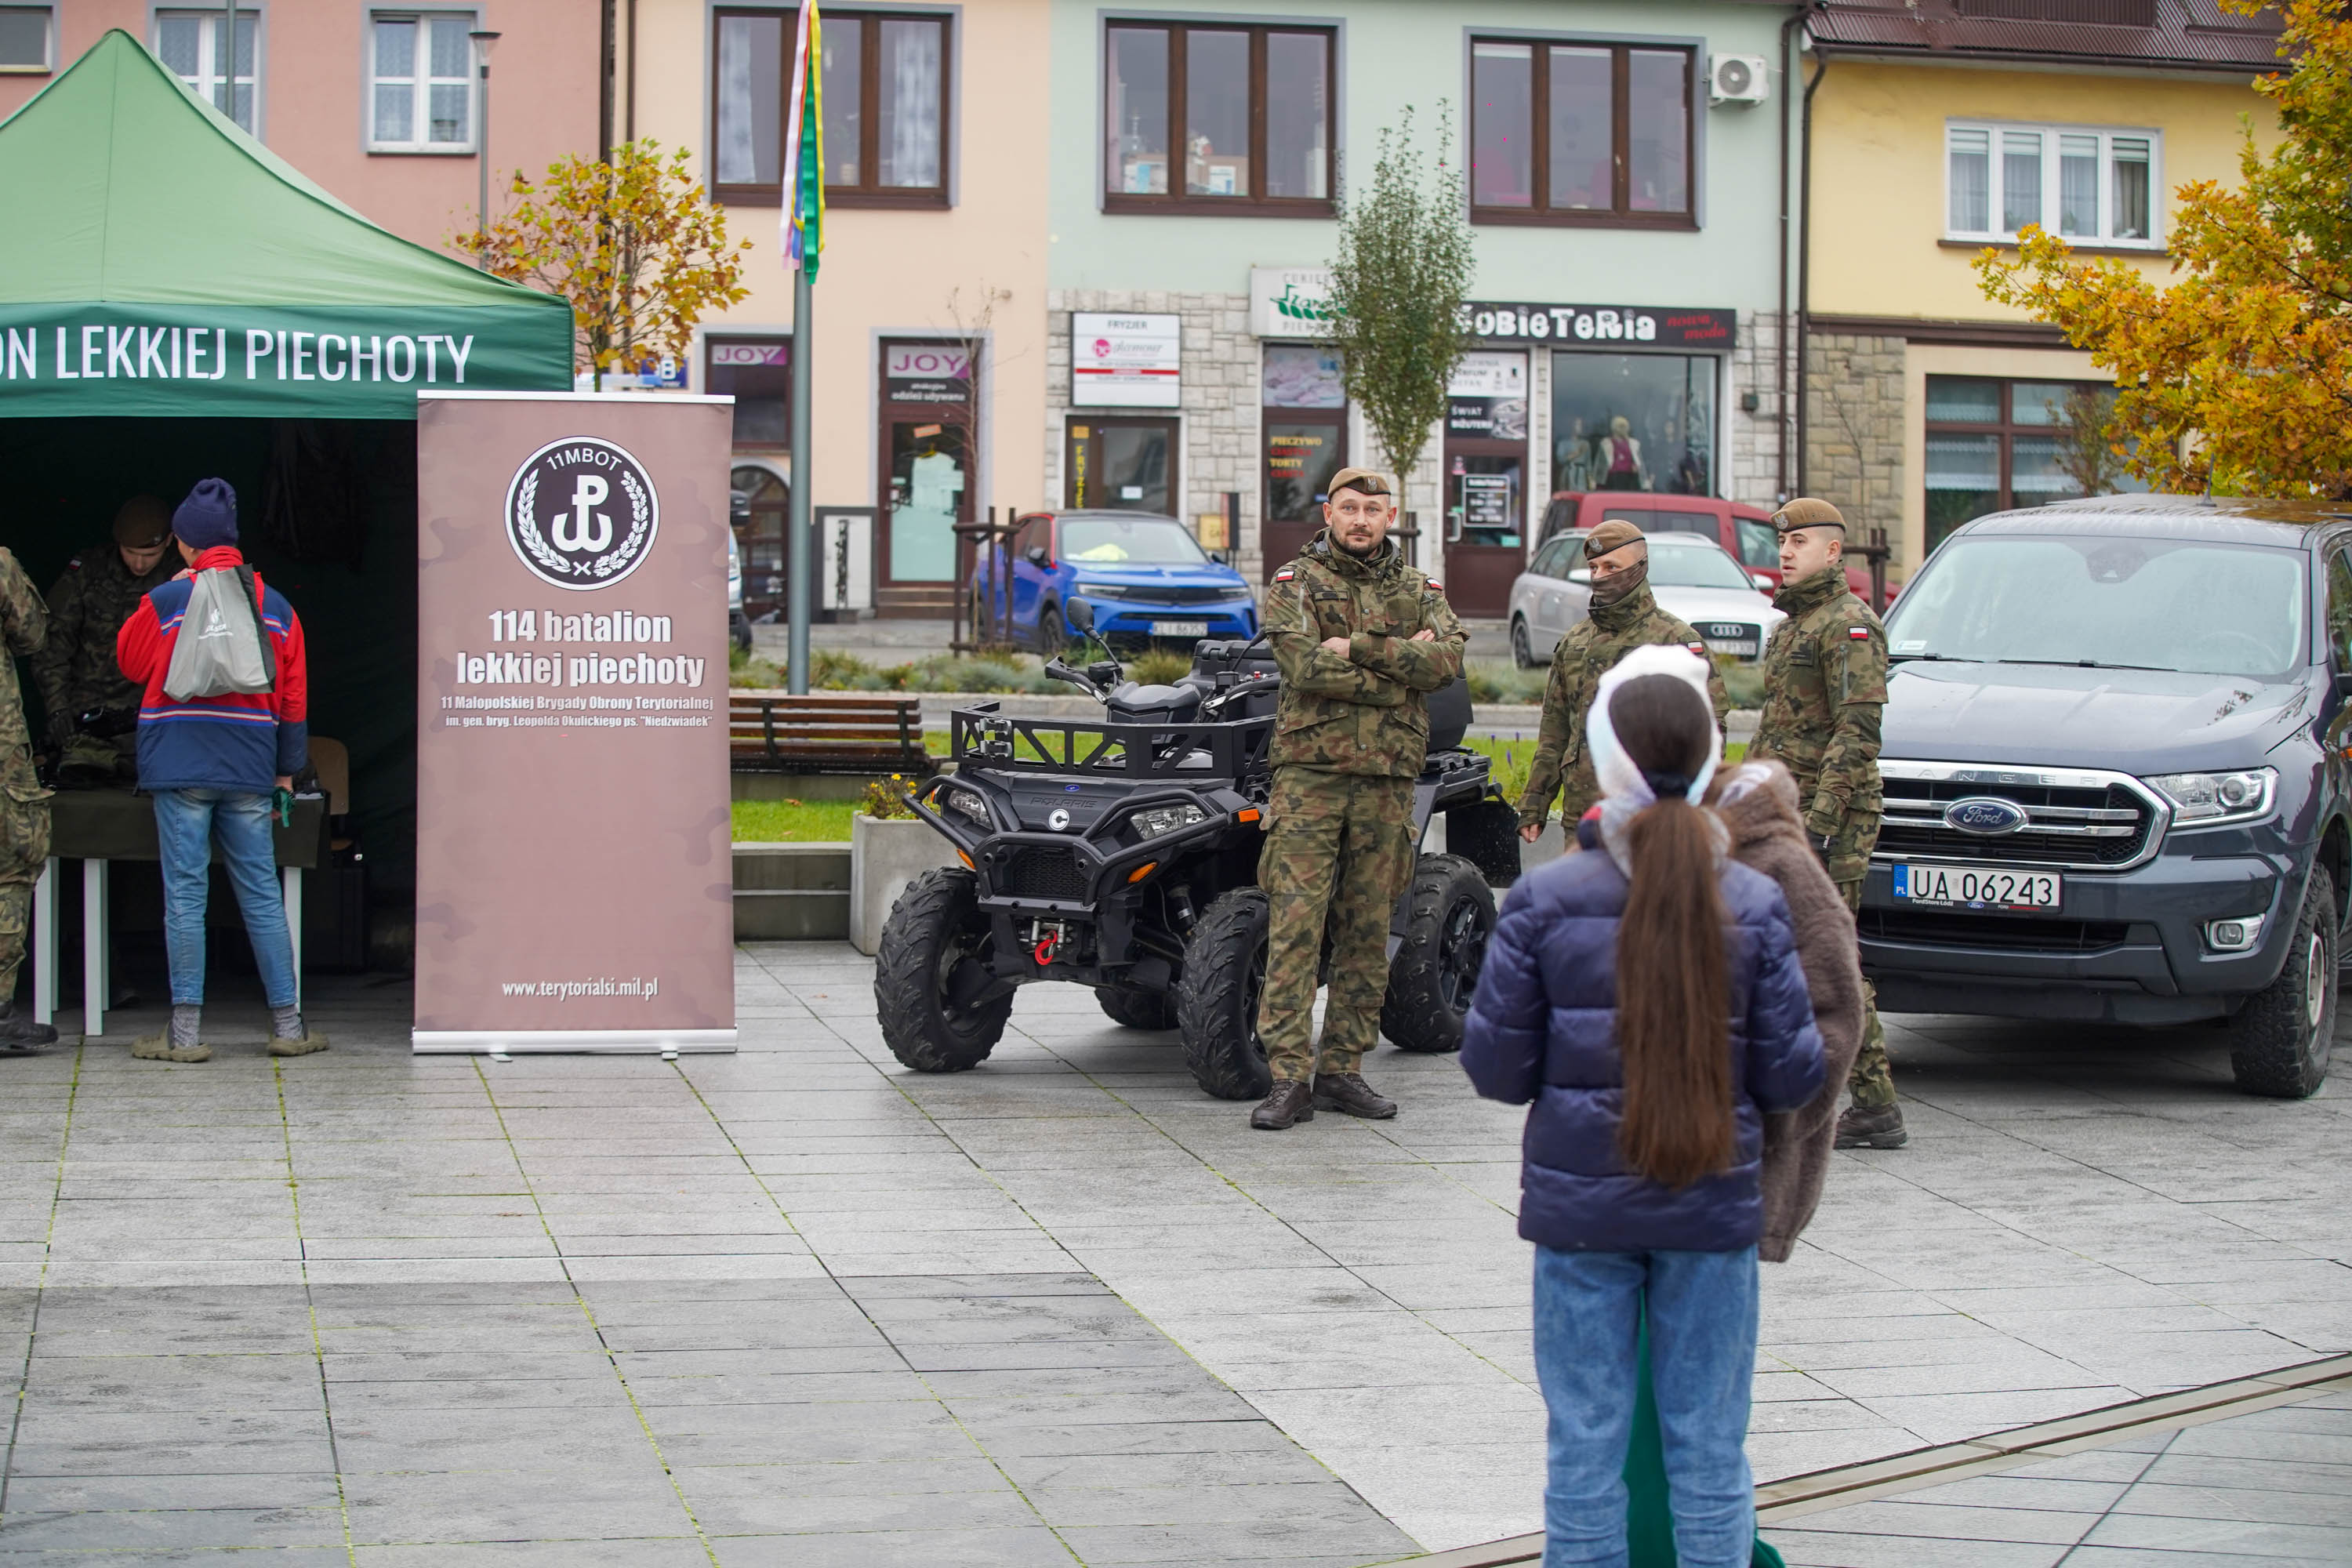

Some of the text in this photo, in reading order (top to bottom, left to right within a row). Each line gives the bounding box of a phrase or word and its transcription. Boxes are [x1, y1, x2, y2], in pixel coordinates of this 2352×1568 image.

[1107, 320, 1148, 330] FRYZJER
[0, 325, 474, 383] N LEKKIEJ PIECHOTY
[717, 347, 775, 365] JOY
[892, 354, 964, 372] JOY
[1271, 437, 1323, 446] PIECZYWO
[546, 448, 622, 470] 11MBOT
[1269, 458, 1304, 468] TORTY
[1075, 445, 1086, 509] FRYZJE
[488, 609, 672, 643] 114 batalion
[457, 652, 705, 688] lekkiej piechoty
[441, 696, 452, 710] 11
[537, 695, 586, 710] Brygady
[590, 695, 633, 710] Obrony
[635, 696, 713, 711] Terytorialnej
[446, 715, 461, 726] im.
[463, 716, 485, 728] gen.
[487, 715, 511, 728] bryg.
[514, 715, 560, 728] Leopolda
[562, 715, 622, 728] Okulickiego
[624, 716, 639, 728] ps.
[1881, 767, 2097, 786] RANGER
[1029, 797, 1098, 808] POLARIS
[1962, 805, 2004, 825] Ford
[1896, 869, 2053, 906] PL UA 06243
[1912, 898, 1940, 906] FordStore
[503, 977, 659, 1002] www.terytorialsi.mil.pl
